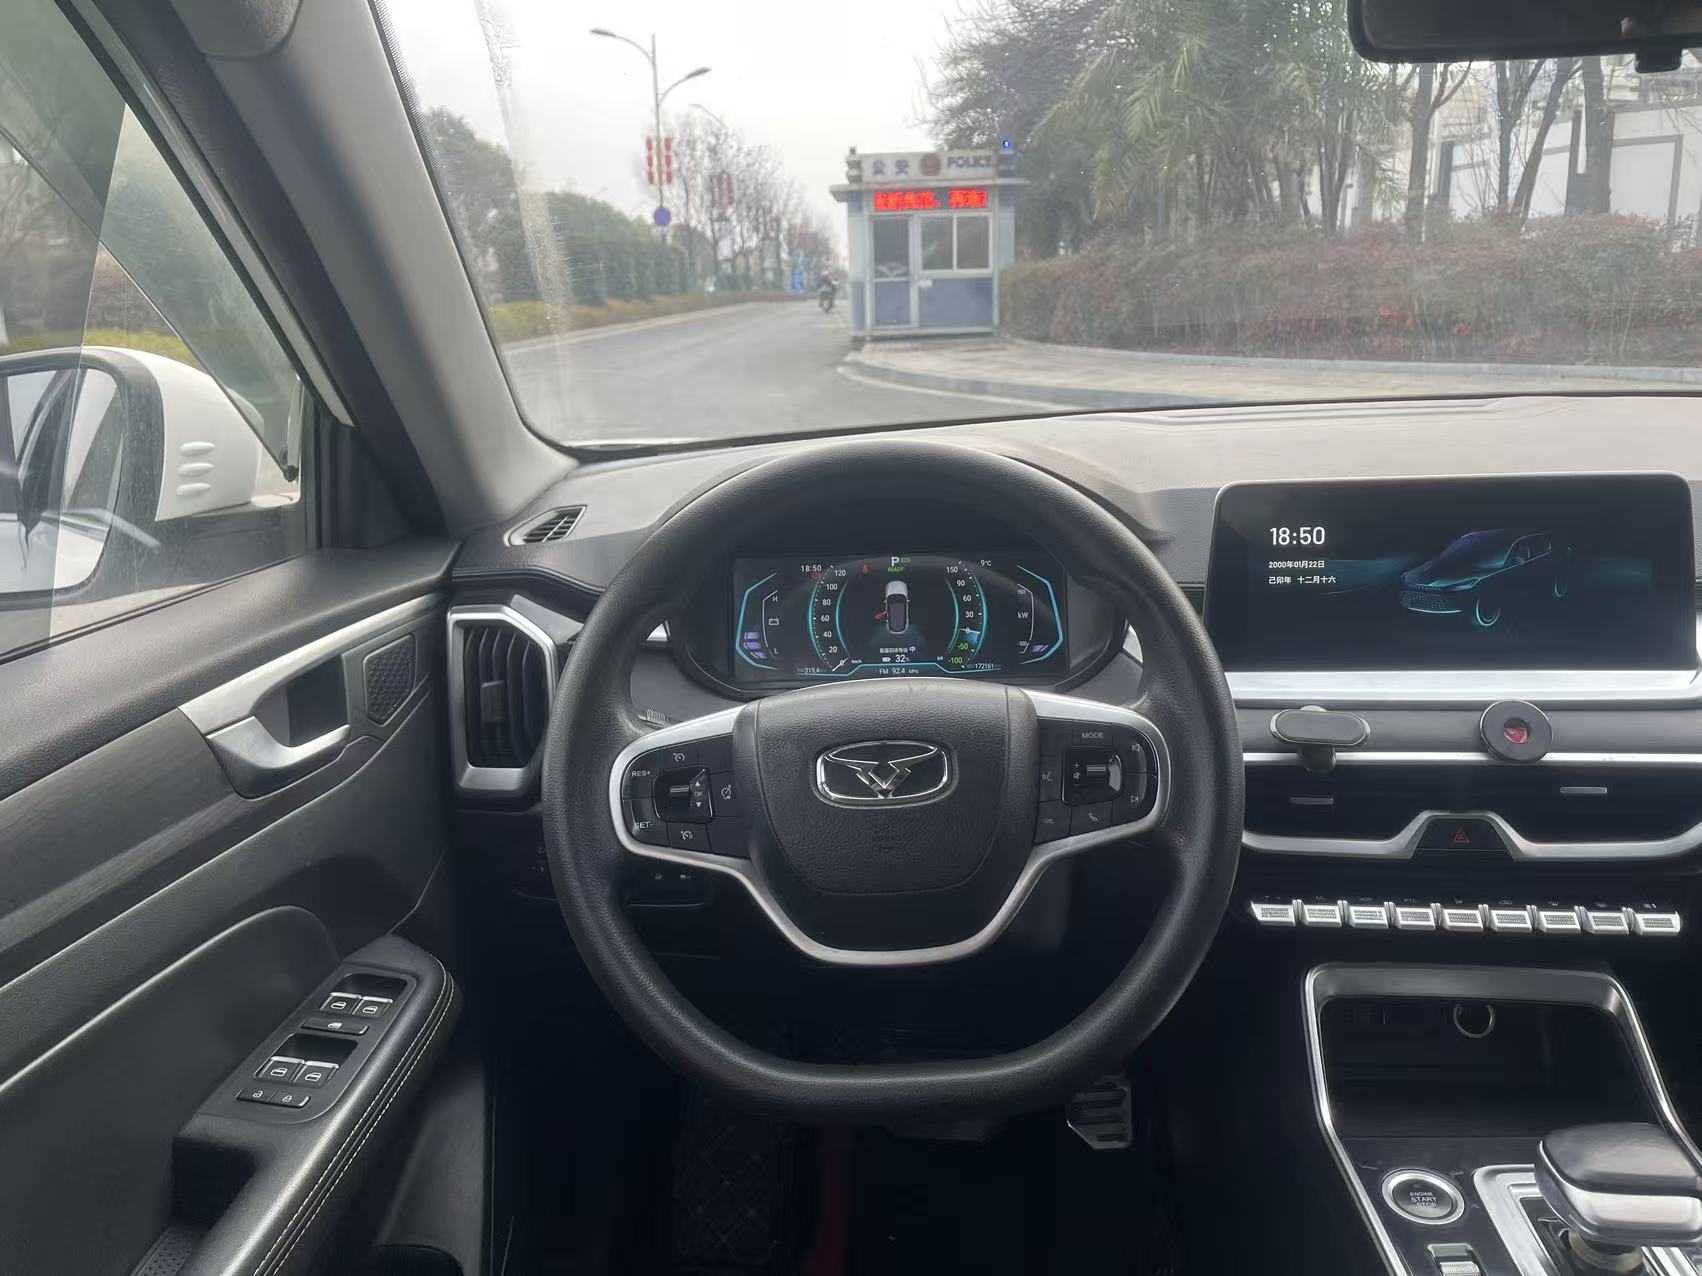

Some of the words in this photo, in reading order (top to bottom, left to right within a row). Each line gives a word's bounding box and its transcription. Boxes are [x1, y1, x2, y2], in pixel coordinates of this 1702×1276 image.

[947, 155, 992, 169] POLICE
[1269, 525, 1326, 547] 18:50
[891, 556, 900, 567] P
[1268, 560, 1326, 569] 2000年01月22日
[800, 564, 822, 573] 18:50
[835, 569, 847, 577] 120
[946, 566, 959, 574] 150
[956, 579, 966, 587] 90
[1268, 575, 1292, 585] 己卯年
[1296, 575, 1337, 585] 十二月十六
[826, 583, 838, 591] 100
[822, 598, 831, 607] 80
[962, 594, 972, 602] 60
[820, 614, 830, 623] 60
[965, 610, 974, 619] 30
[823, 630, 832, 638] 40
[828, 646, 838, 654] 20
[880, 667, 889, 675] FM
[891, 666, 906, 675] 92.4
[1081, 731, 1104, 739] MODE
